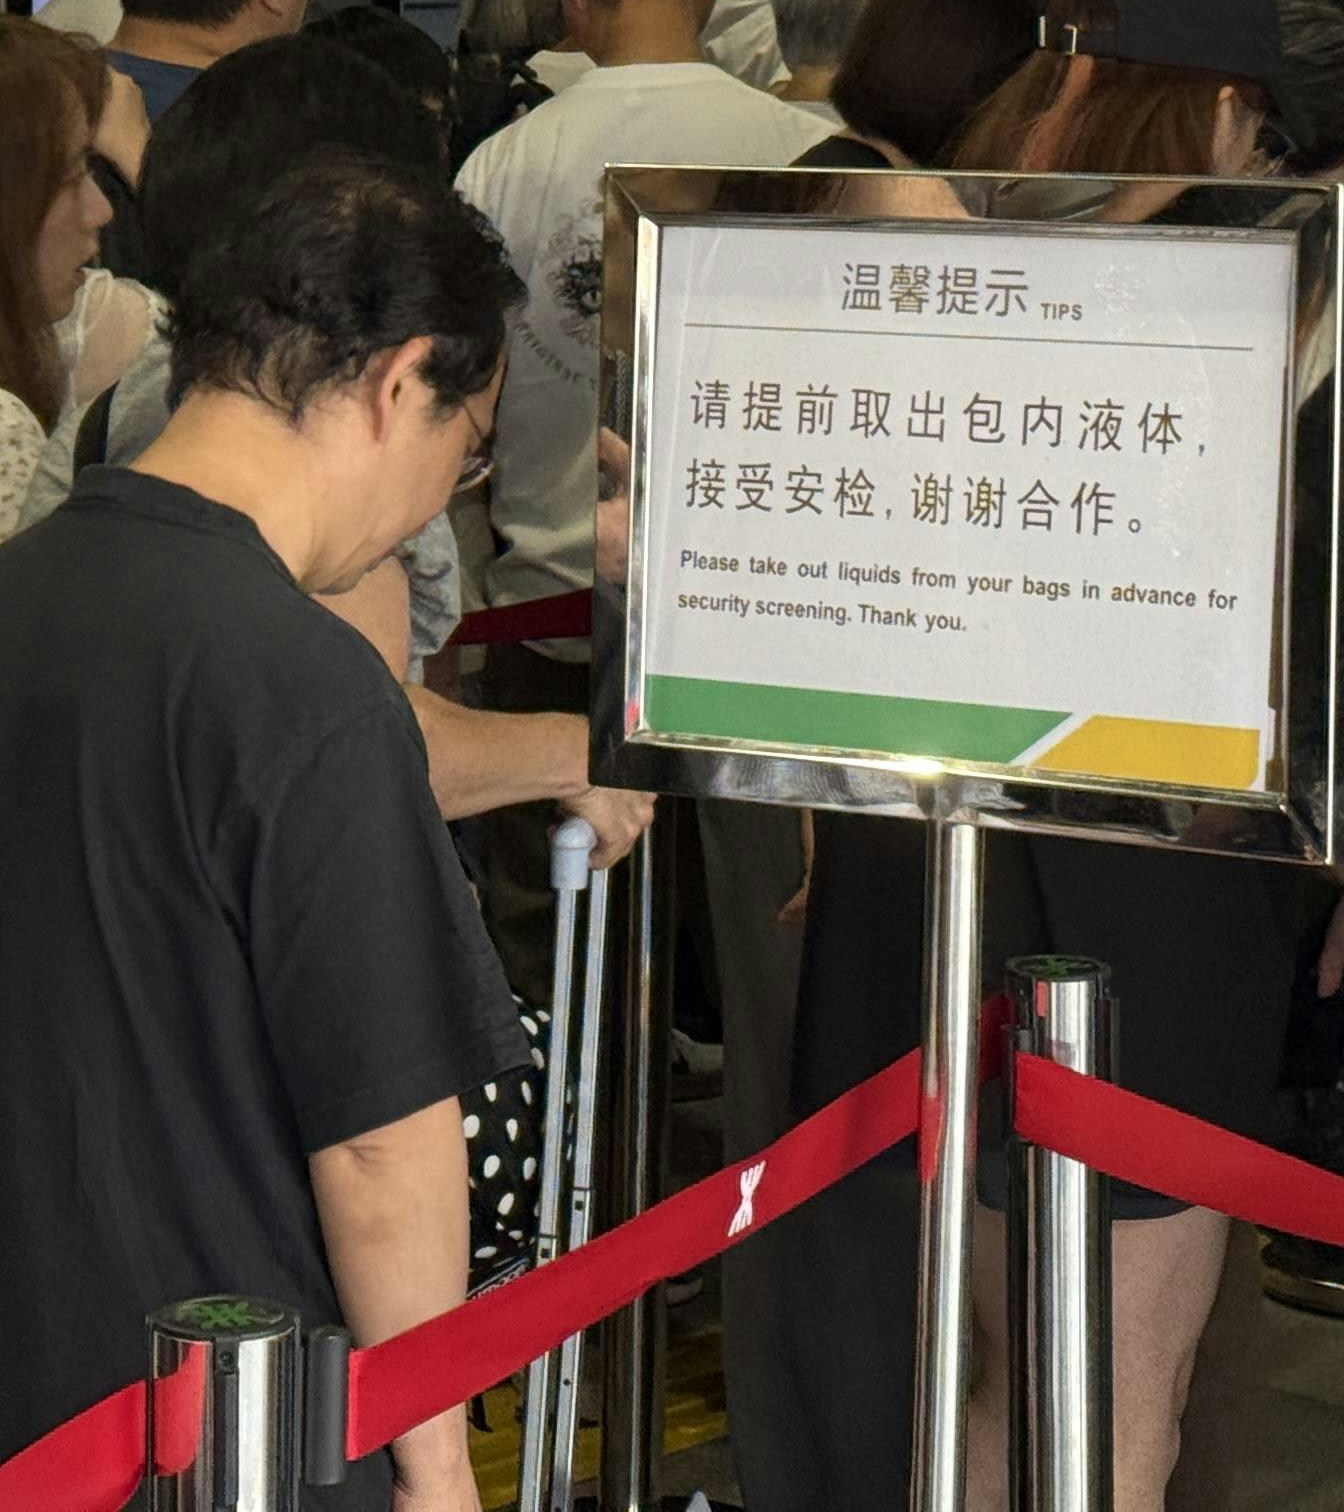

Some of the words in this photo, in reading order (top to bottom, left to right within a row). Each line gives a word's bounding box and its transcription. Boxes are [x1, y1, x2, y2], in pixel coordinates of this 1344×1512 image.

[841, 263, 1029, 317] 温馨提示
[1040, 302, 1083, 321] TIPS
[680, 549, 740, 573] Please
[749, 555, 788, 576] take
[797, 561, 828, 580] out
[838, 561, 902, 586] liquids
[911, 566, 957, 589] from
[967, 574, 1013, 595] your
[1022, 574, 1071, 601] bags
[1082, 579, 1100, 600] in
[1111, 582, 1197, 608] advance
[1207, 589, 1238, 611] for
[678, 593, 750, 618] security
[755, 599, 852, 626] screening.
[857, 603, 917, 627] Thank
[925, 612, 967, 633] you.
